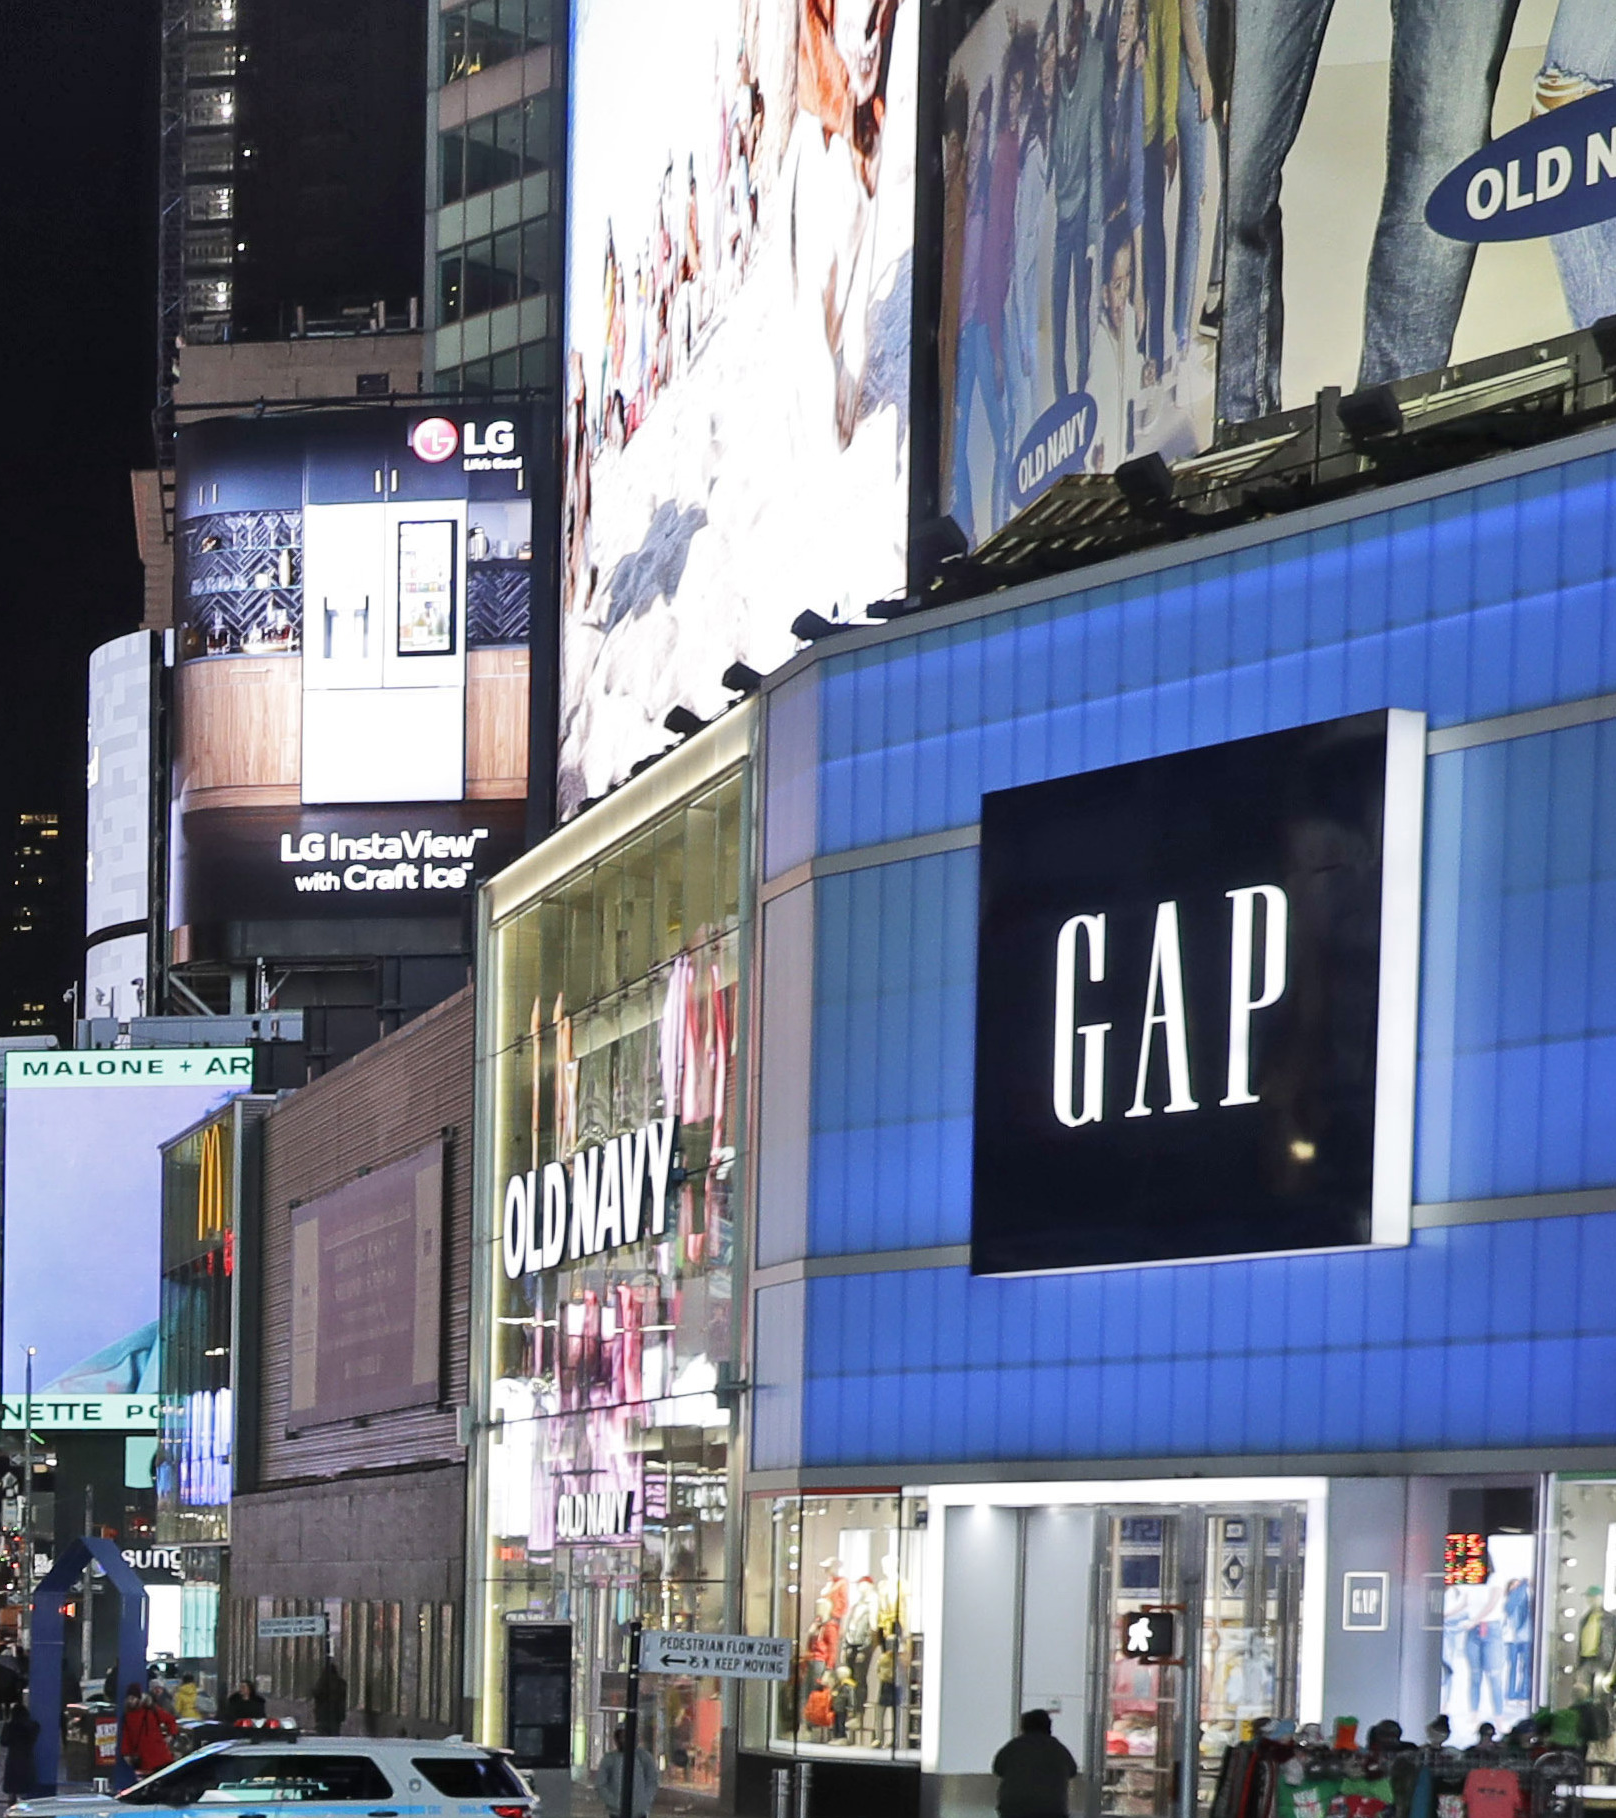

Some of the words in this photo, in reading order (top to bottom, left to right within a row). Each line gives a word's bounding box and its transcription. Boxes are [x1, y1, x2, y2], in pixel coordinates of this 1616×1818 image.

[1466, 145, 1571, 222] OLD
[462, 420, 515, 455] LG
[1017, 449, 1046, 497] OLD
[1047, 407, 1089, 466] NAVY
[280, 832, 325, 863] LG
[295, 869, 340, 892] with
[343, 864, 419, 891] Craft
[423, 864, 467, 889] Ice
[1052, 882, 1289, 1129] GAP
[22, 1059, 164, 1076] MALONE
[502, 1160, 567, 1281] OLD
[570, 1115, 679, 1261] NAVY
[557, 1493, 587, 1538] OLD
[587, 1489, 629, 1537] NAVY
[1352, 1588, 1380, 1614] GAP
[659, 1635, 724, 1653] PEDESTRIAN
[726, 1640, 754, 1654] FLOW
[757, 1642, 785, 1657] ZONE
[713, 1657, 741, 1672] KEEP
[743, 1659, 784, 1674] MOVING
